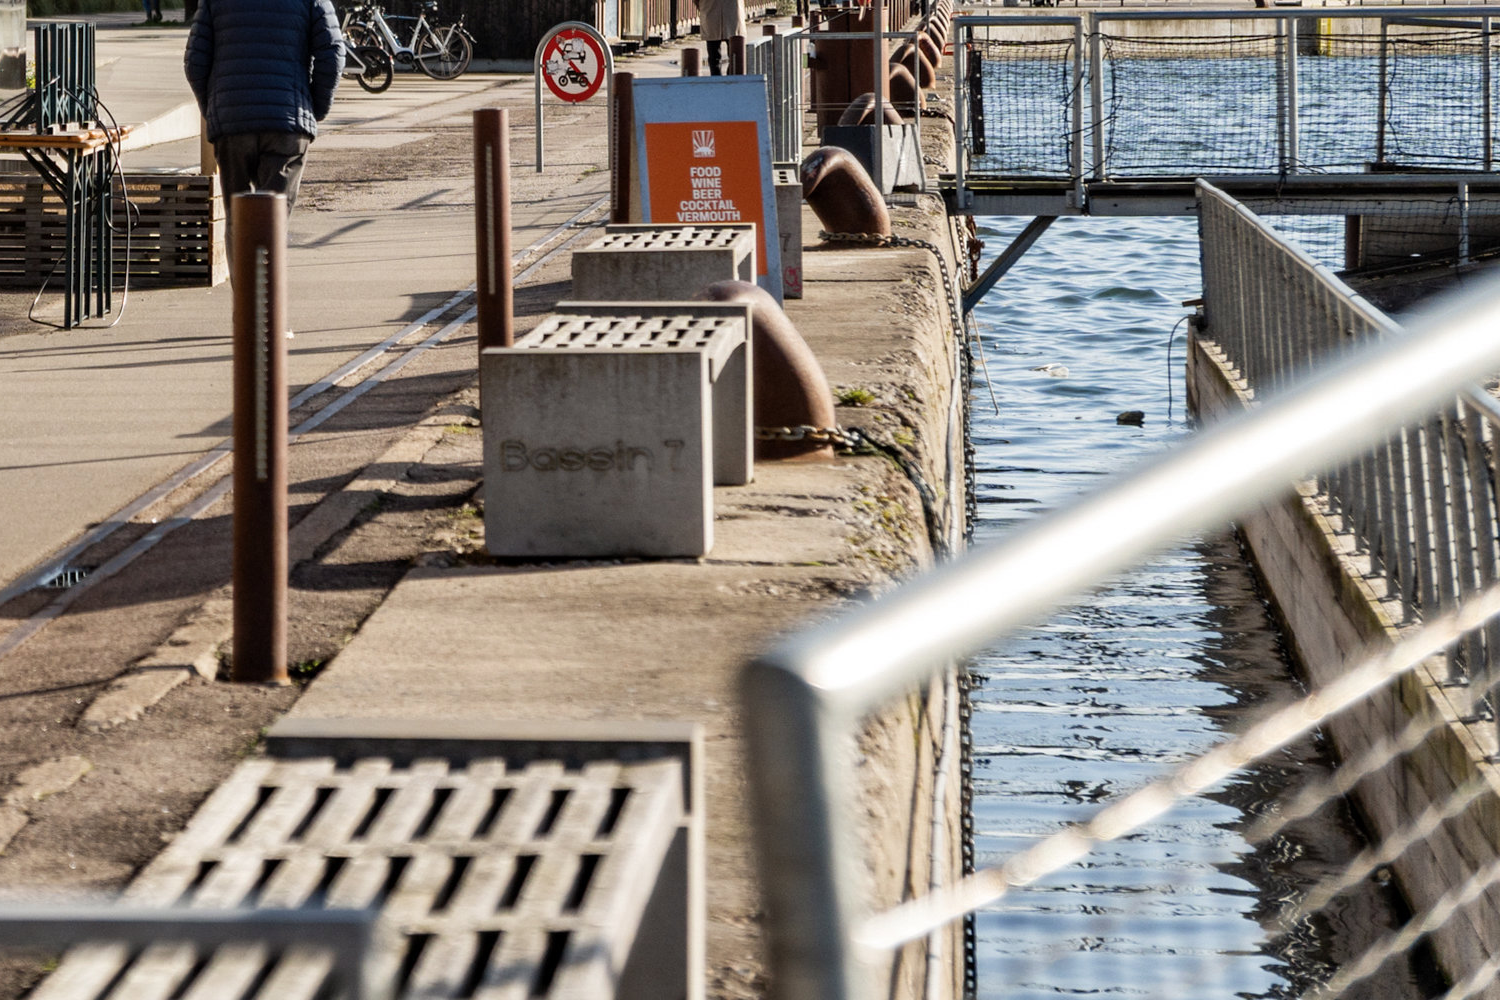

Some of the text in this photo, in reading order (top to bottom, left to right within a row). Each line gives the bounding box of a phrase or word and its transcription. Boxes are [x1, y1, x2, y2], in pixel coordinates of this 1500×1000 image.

[690, 166, 721, 177] FOOD
[691, 178, 722, 188] WINE
[692, 189, 722, 199] BEER
[680, 199, 736, 211] COCKTAIL
[676, 210, 741, 222] VERMOUTH
[499, 438, 685, 472] Bassin 7
